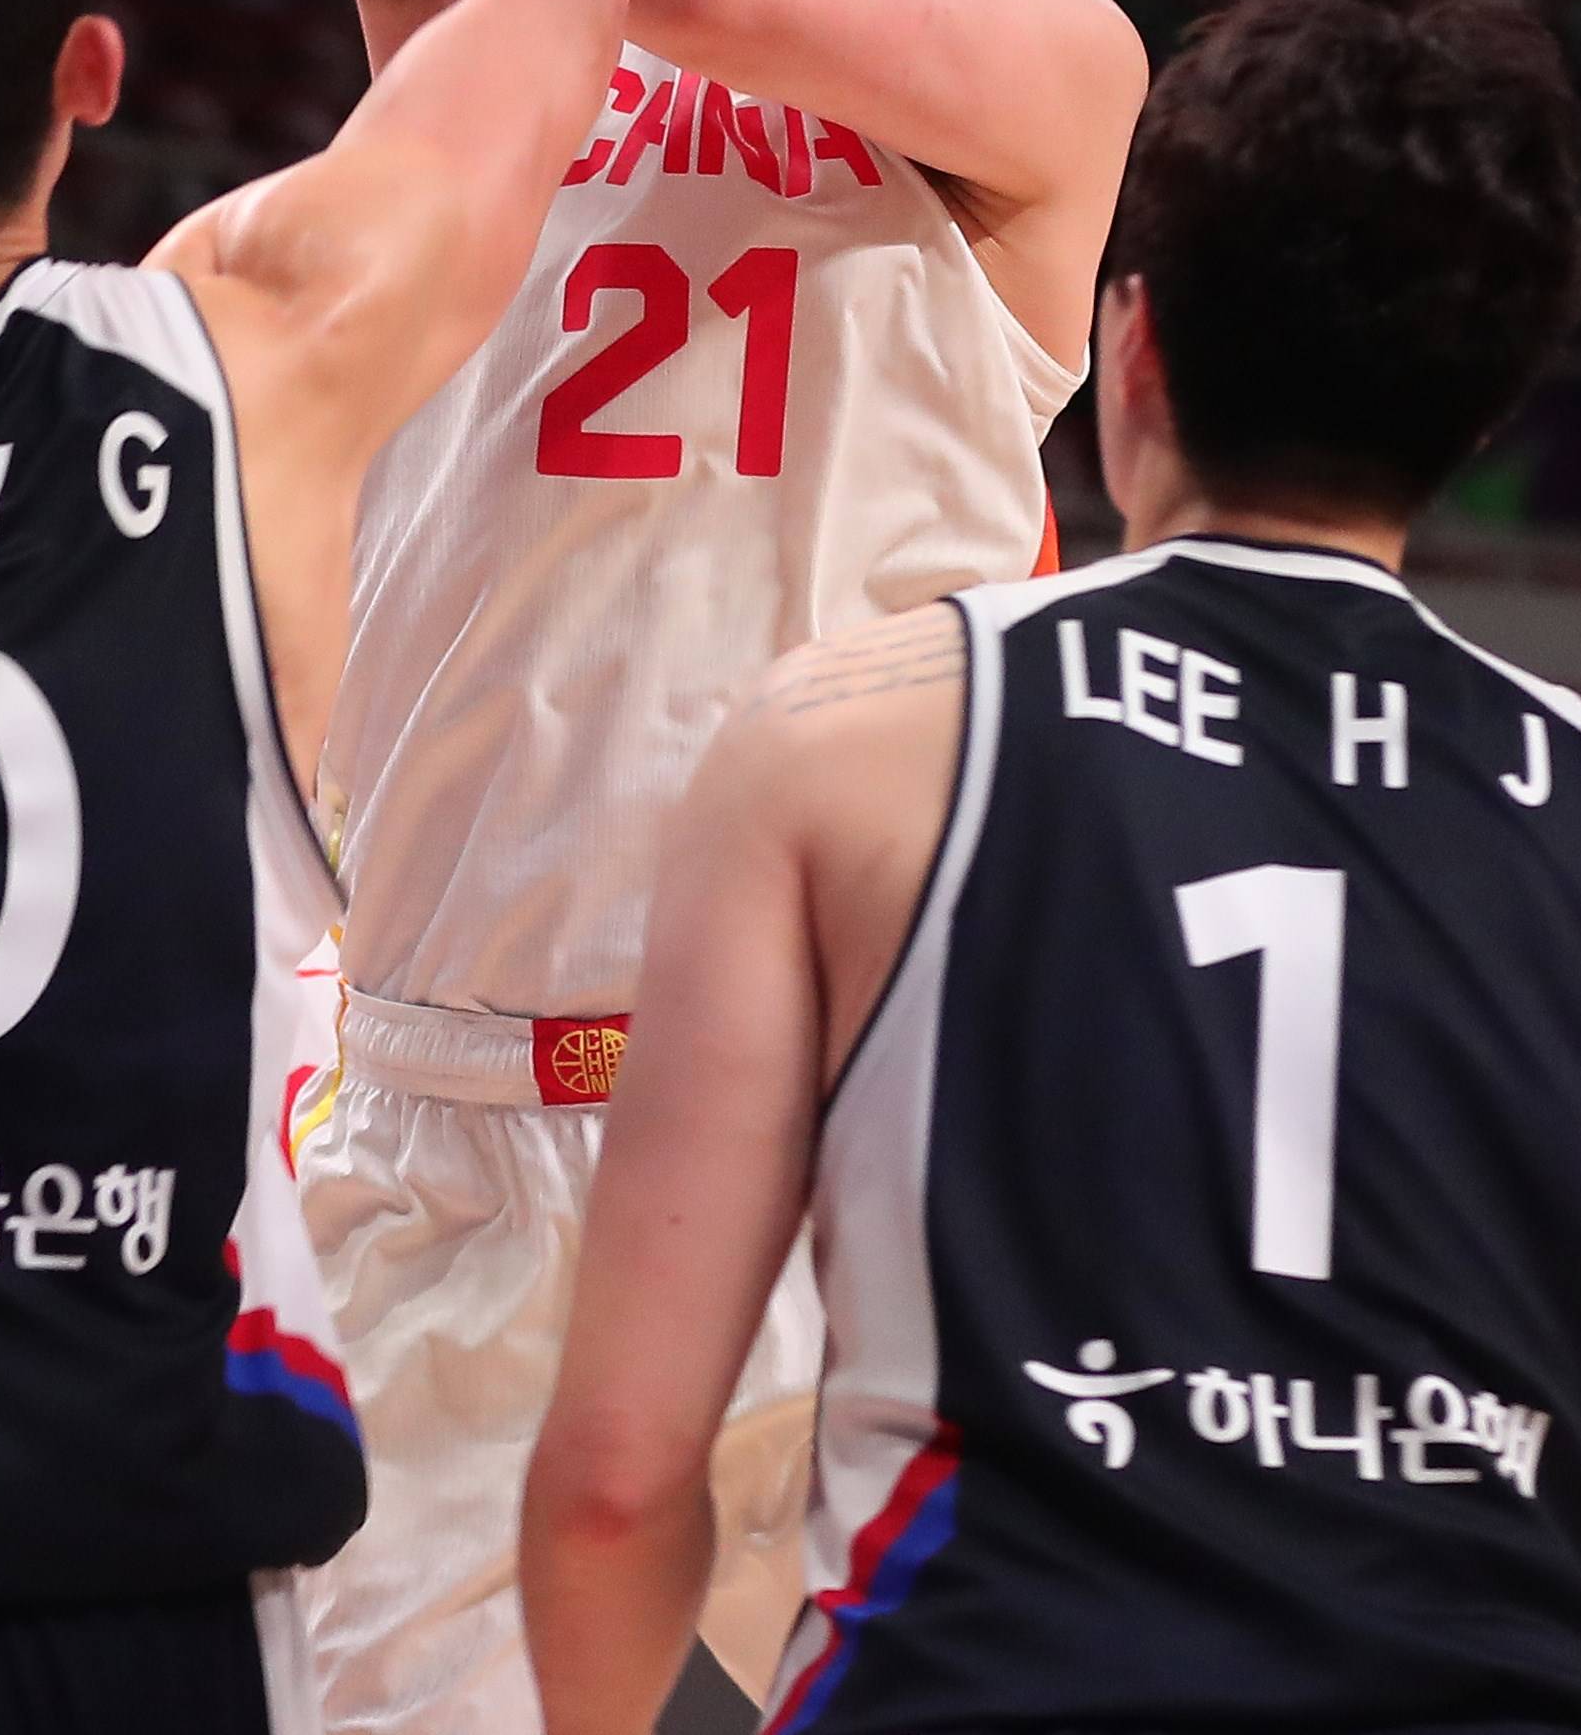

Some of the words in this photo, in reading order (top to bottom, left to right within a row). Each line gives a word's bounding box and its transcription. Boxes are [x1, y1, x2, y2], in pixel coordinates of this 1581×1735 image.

[535, 242, 800, 480] 21
[97, 409, 172, 539] G
[1056, 618, 1245, 767] LEE
[1329, 670, 1410, 790] H
[1497, 712, 1554, 808] J
[1172, 862, 1347, 1280] 1
[1184, 1365, 1551, 1499] 하나은행
